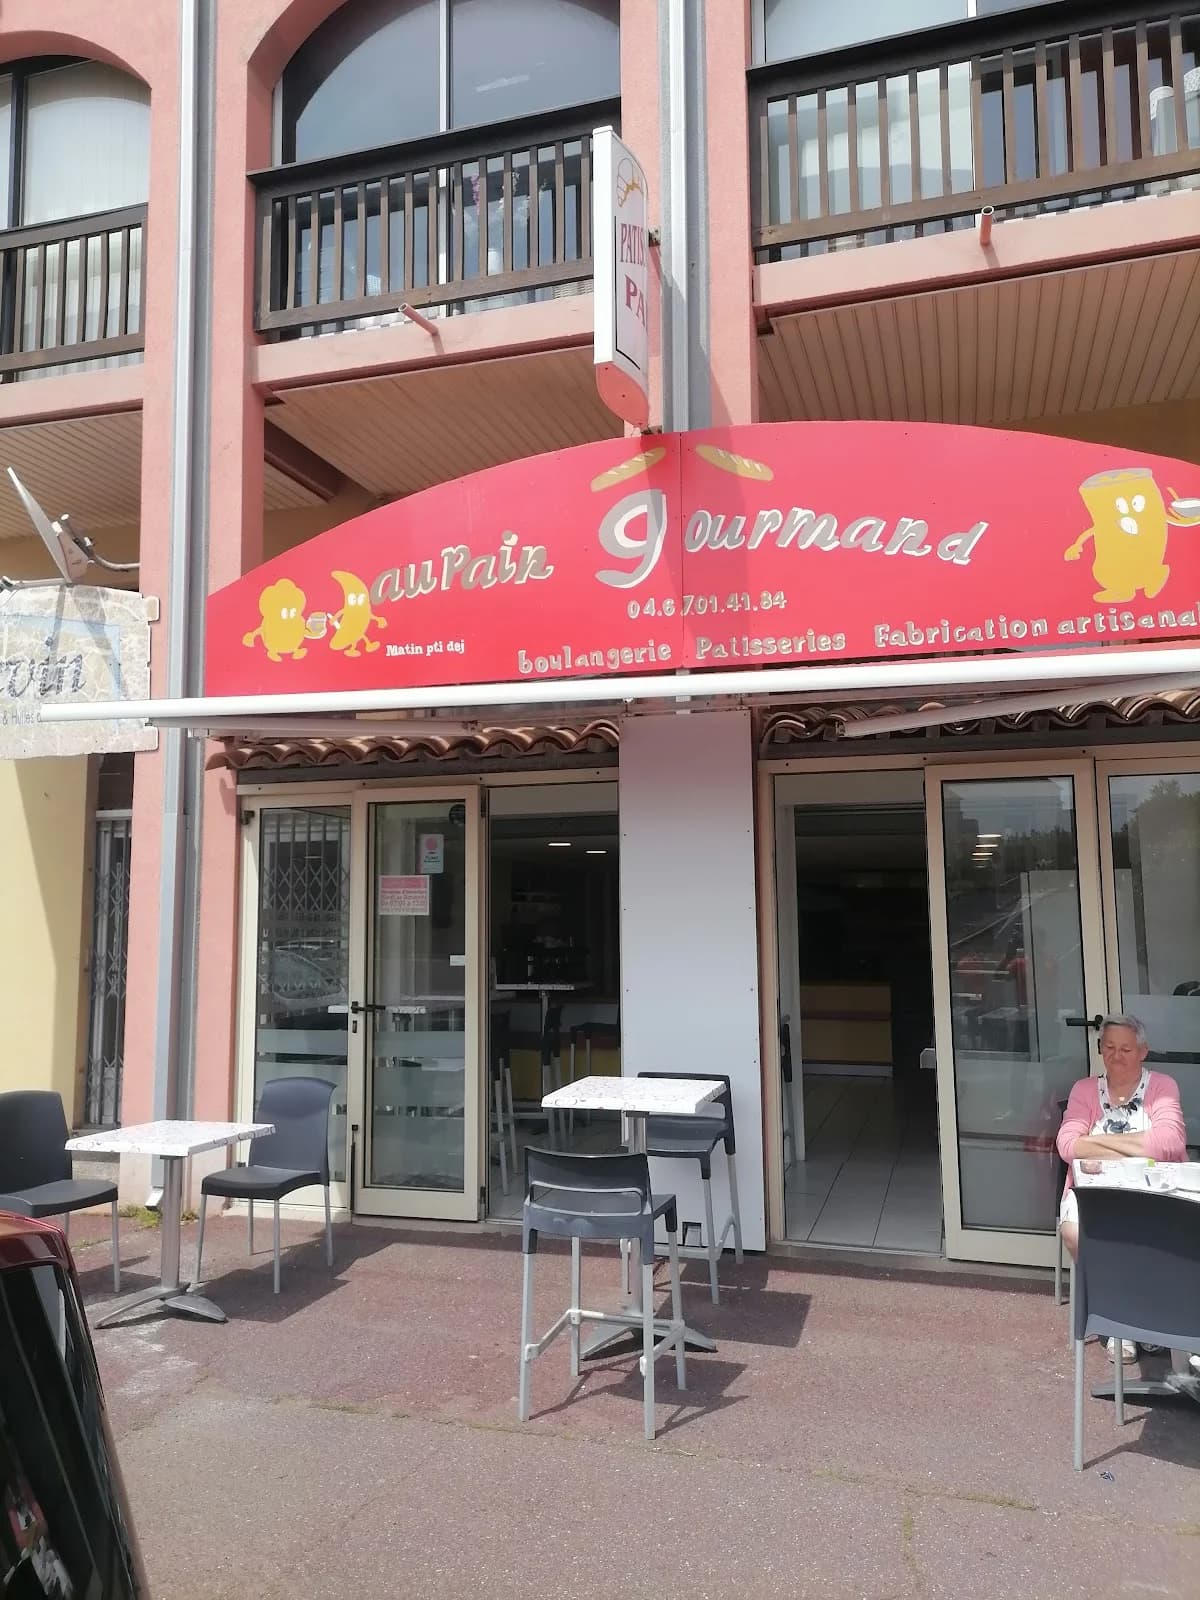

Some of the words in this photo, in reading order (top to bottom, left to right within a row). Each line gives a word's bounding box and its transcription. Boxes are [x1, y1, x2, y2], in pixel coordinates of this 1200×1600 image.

[620, 223, 648, 268] PATIS
[625, 273, 648, 336] PA
[386, 643, 423, 657] Matin
[426, 641, 443, 656] pti
[447, 639, 465, 654] dej
[517, 640, 672, 674] boulangerie
[695, 628, 846, 660] Patisseries
[874, 615, 1049, 648] Fabrication
